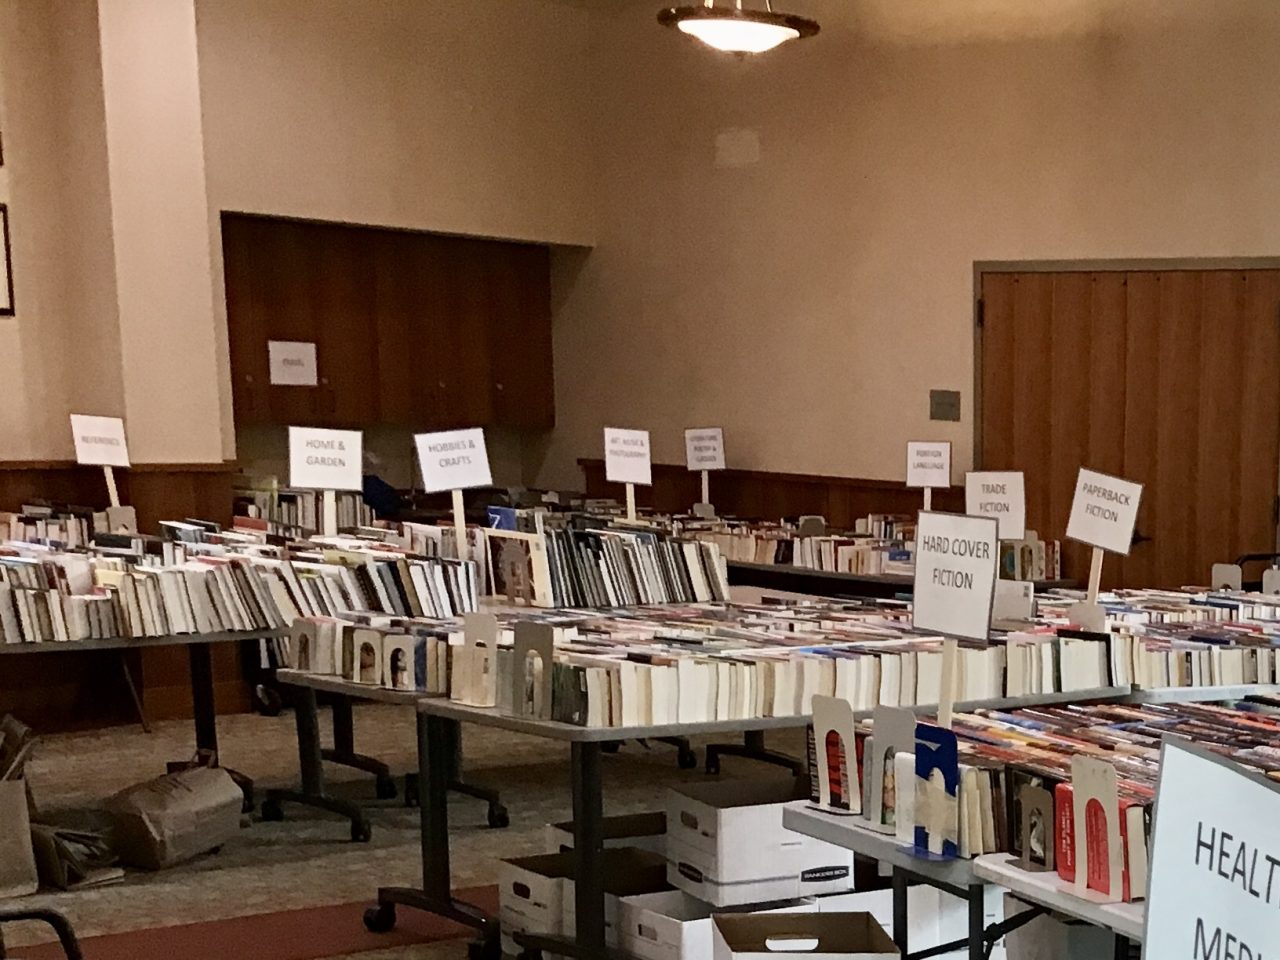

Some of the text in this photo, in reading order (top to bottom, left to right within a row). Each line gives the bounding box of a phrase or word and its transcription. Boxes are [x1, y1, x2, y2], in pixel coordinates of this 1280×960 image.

[306, 439, 346, 451] HOME &
[428, 439, 476, 454] HOBBIES &
[306, 456, 346, 467] GARDEN
[439, 456, 472, 468] CRAFTS
[913, 461, 945, 471] LANGUAGE
[981, 483, 1007, 495] TRADE
[1082, 482, 1131, 506] PAPERBACK
[979, 502, 1010, 513] FICTION
[1085, 504, 1118, 523] FICTION
[923, 535, 990, 560] HARD COVER
[932, 569, 973, 590] FICTION
[804, 867, 849, 880] BANKERS BOX
